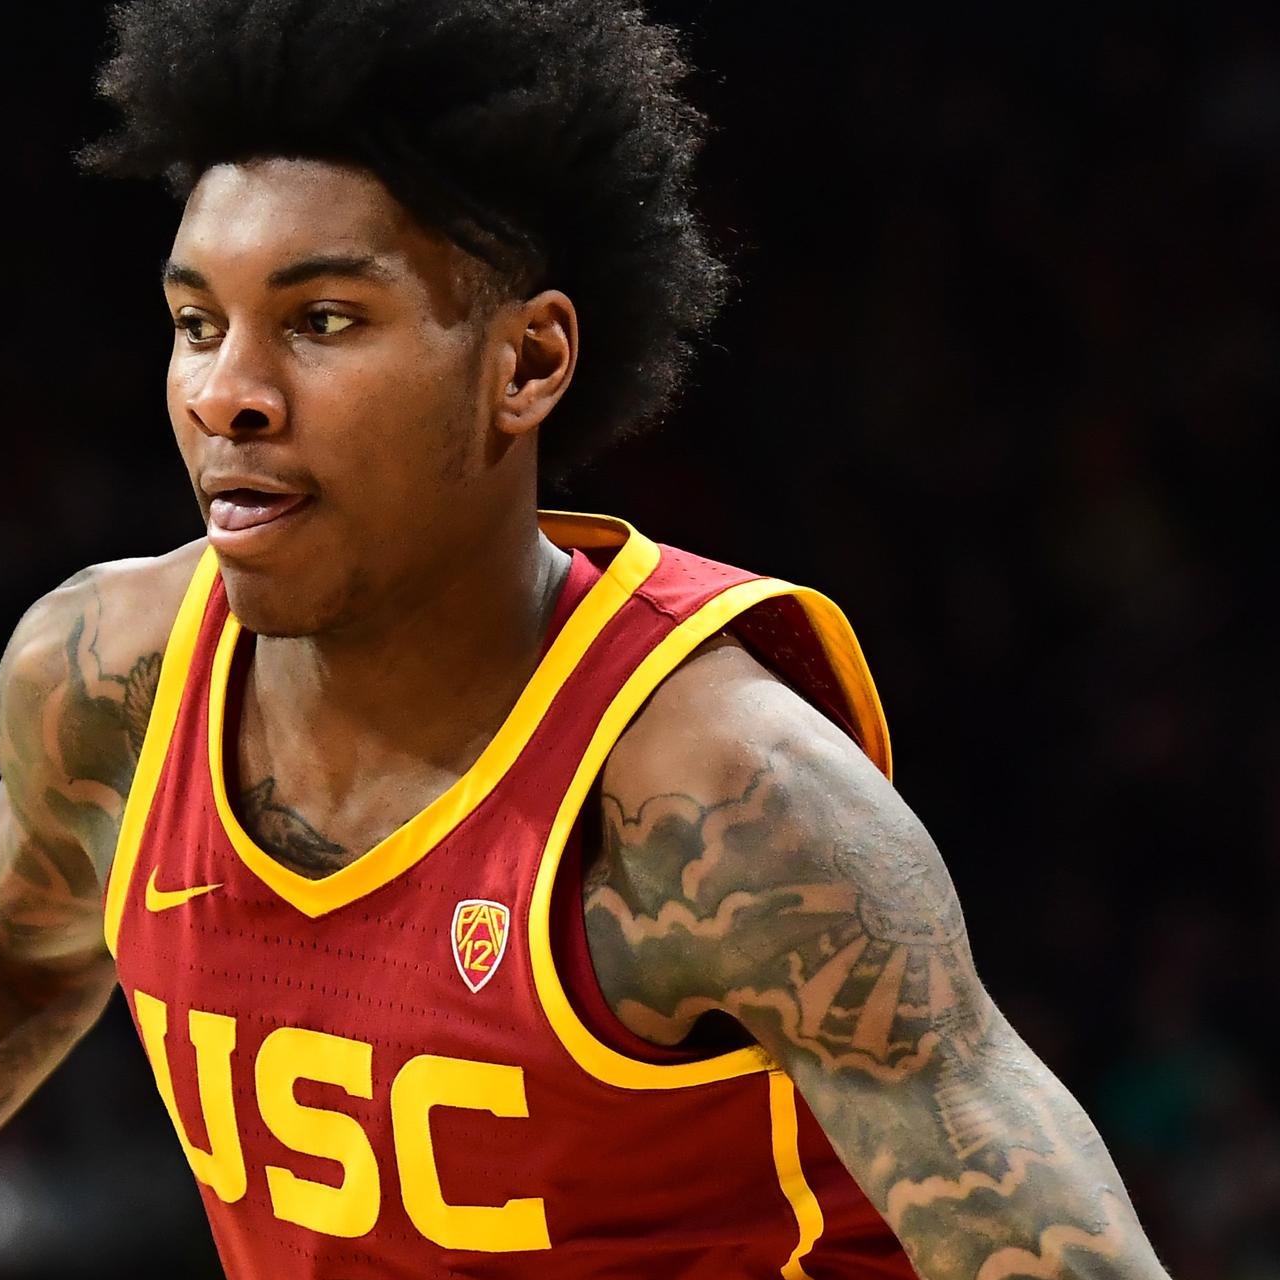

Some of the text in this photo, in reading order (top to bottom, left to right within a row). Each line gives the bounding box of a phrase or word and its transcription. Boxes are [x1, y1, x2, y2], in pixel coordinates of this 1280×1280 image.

[457, 905, 506, 956] PAC
[464, 939, 493, 971] 12
[134, 989, 552, 1253] USC
